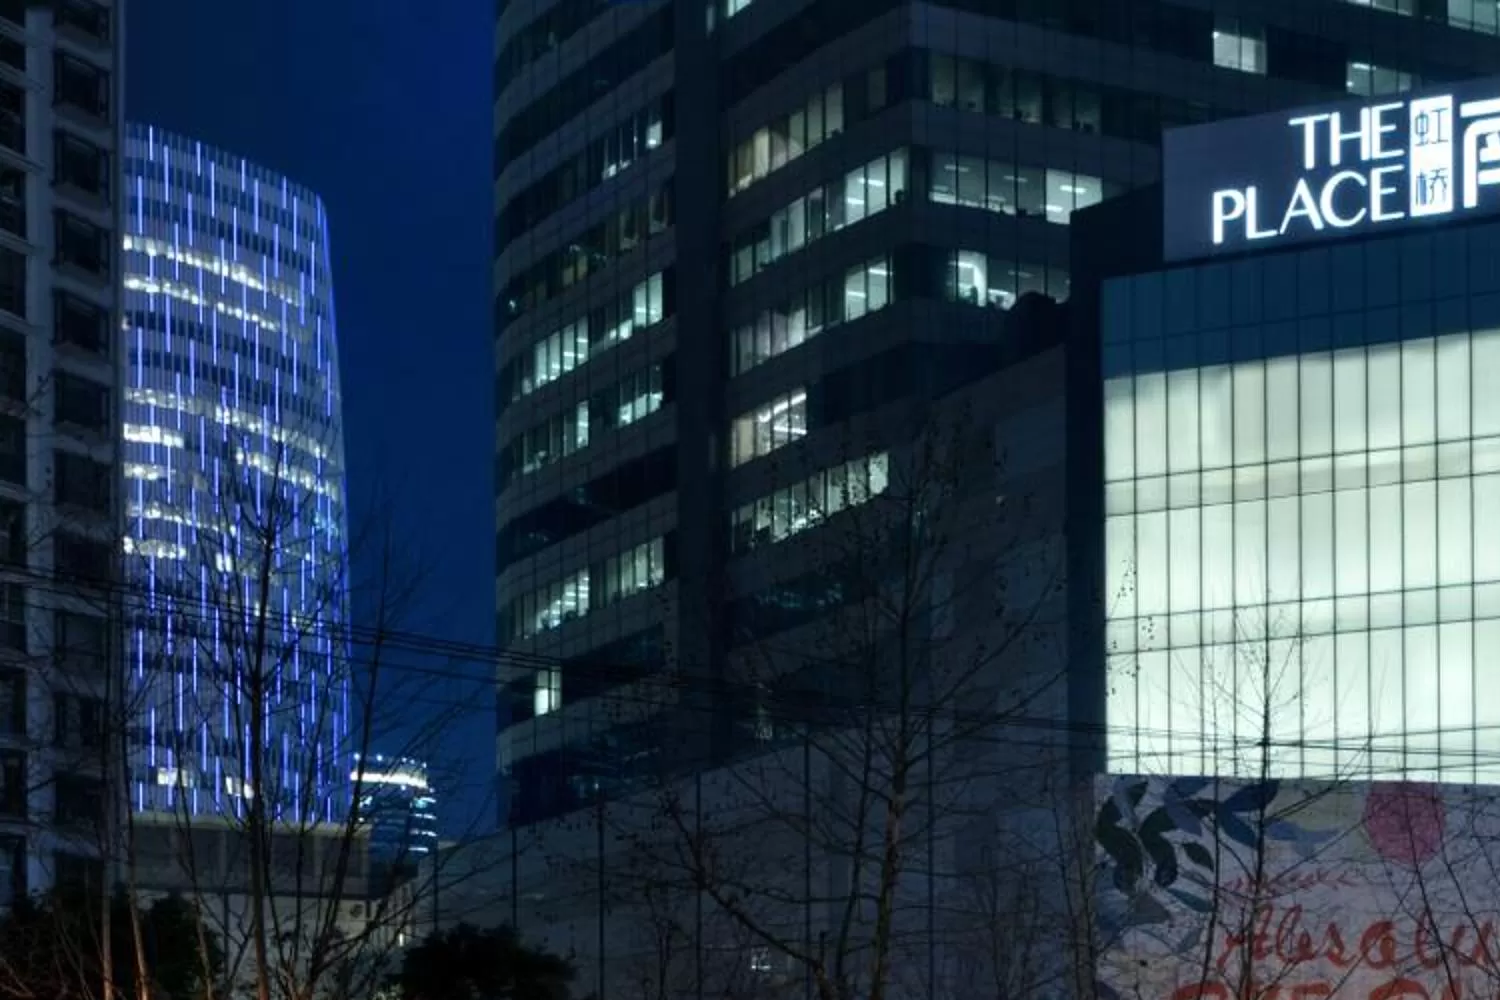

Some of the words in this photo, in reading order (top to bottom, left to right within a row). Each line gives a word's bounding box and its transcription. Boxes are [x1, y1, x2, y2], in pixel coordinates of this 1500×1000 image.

[1288, 102, 1405, 171] THE
[1414, 106, 1449, 206] 虹桥
[1211, 165, 1405, 244] PLACE
